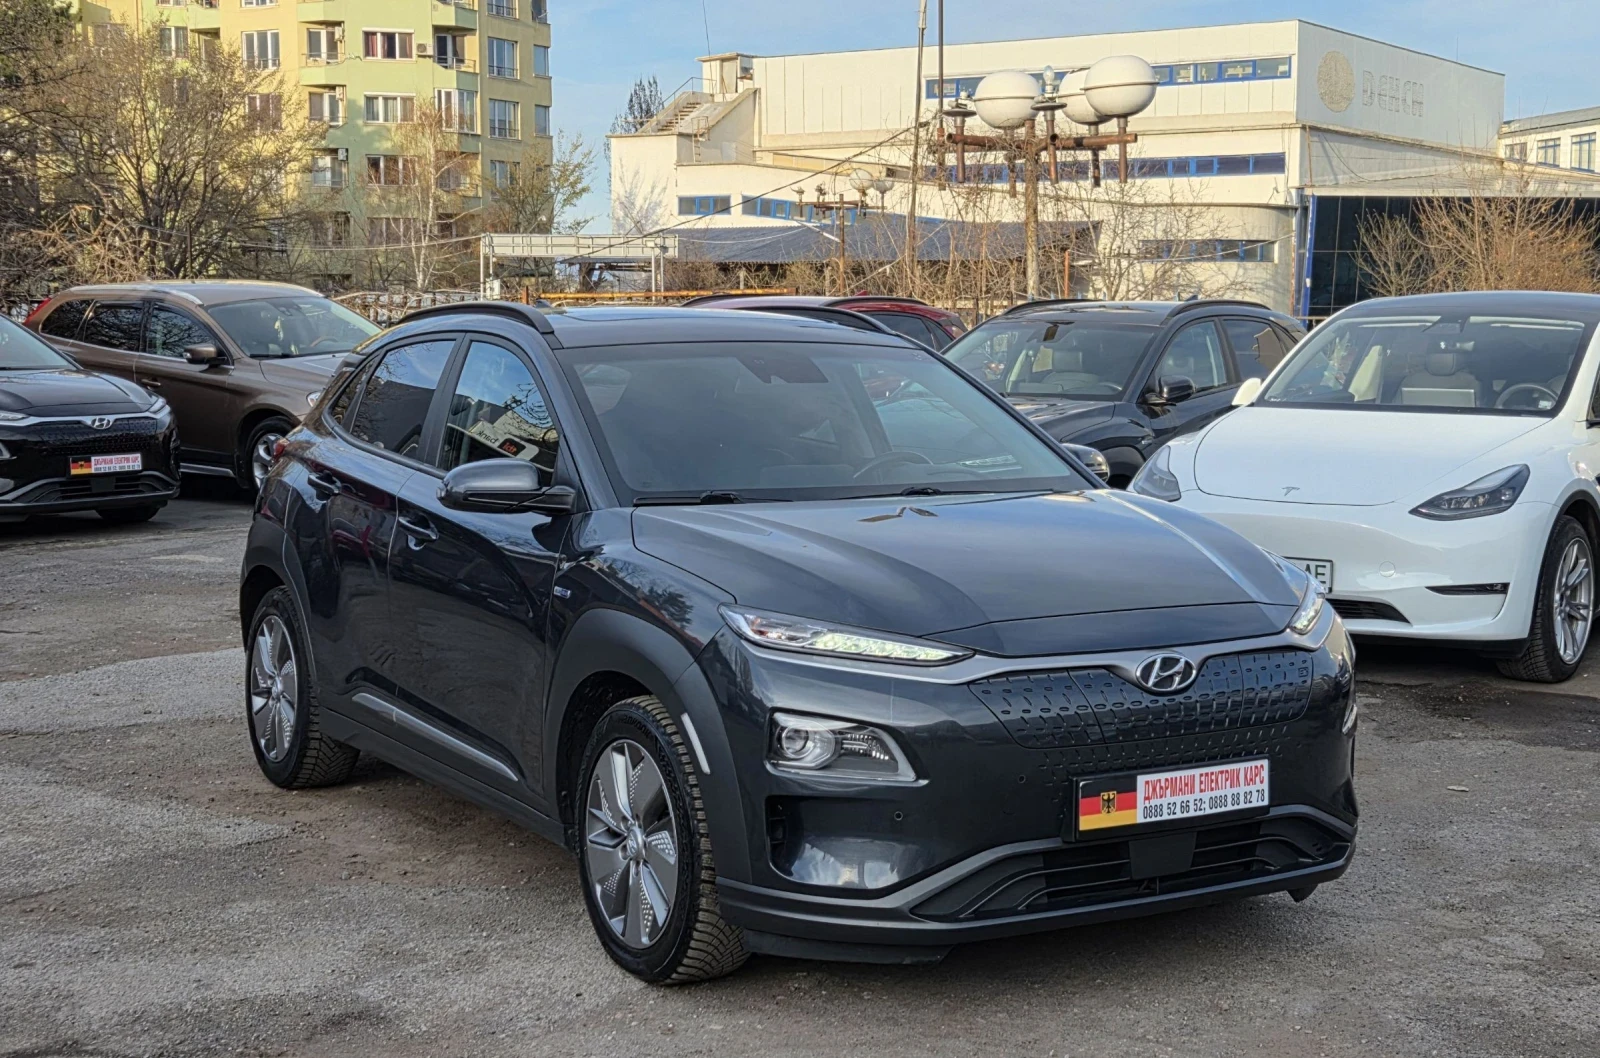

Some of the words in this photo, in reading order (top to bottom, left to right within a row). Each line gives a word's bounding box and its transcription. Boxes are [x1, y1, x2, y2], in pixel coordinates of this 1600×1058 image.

[1143, 773, 1196, 805] ДЖЪРМАНИ
[1199, 768, 1241, 793] ЕЛЕКТРИК
[1243, 763, 1265, 787] КАРС
[1143, 803, 1164, 819] 0888
[1166, 802, 1177, 816] 52
[1180, 800, 1190, 814] 66
[1193, 798, 1206, 814] 52;
[1208, 794, 1228, 810] 0888
[1231, 792, 1241, 806] 88
[1243, 790, 1253, 804] 82
[1256, 788, 1265, 802] 78
